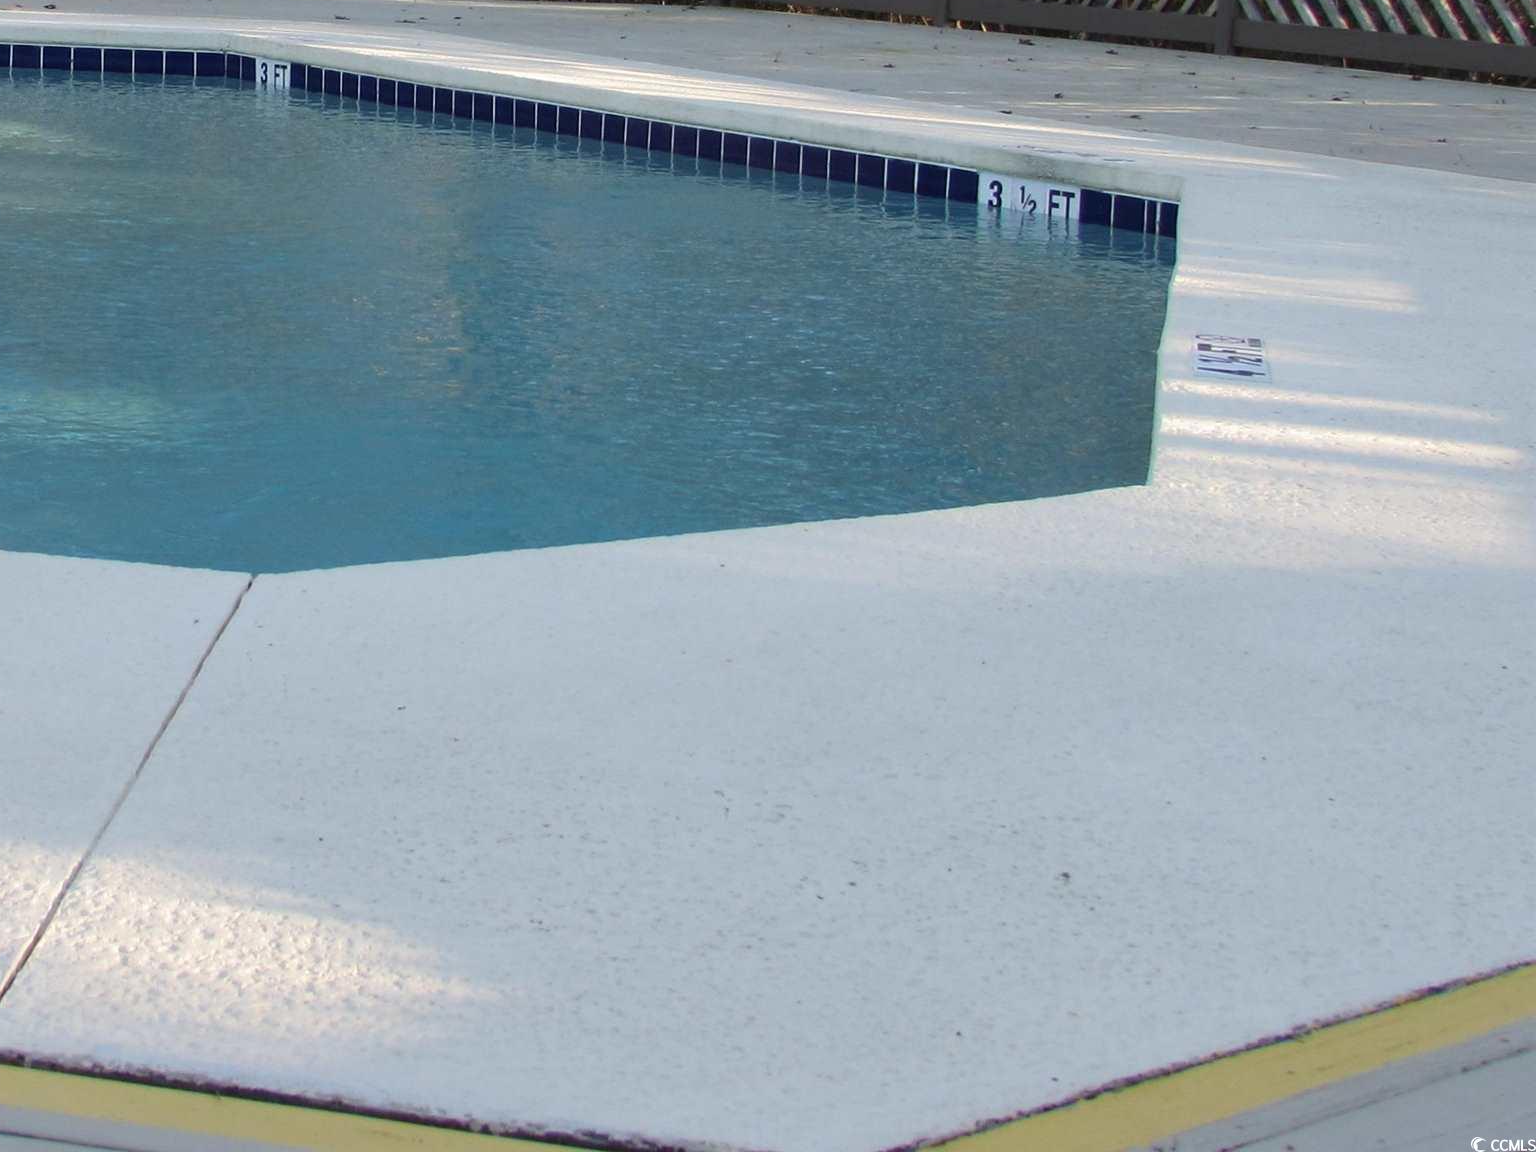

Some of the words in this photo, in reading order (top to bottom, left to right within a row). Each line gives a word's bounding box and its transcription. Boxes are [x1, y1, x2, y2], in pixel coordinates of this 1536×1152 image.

[260, 62, 269, 83] 3
[274, 64, 288, 88] FT
[989, 180, 1003, 208] 3
[1048, 189, 1075, 219] FT
